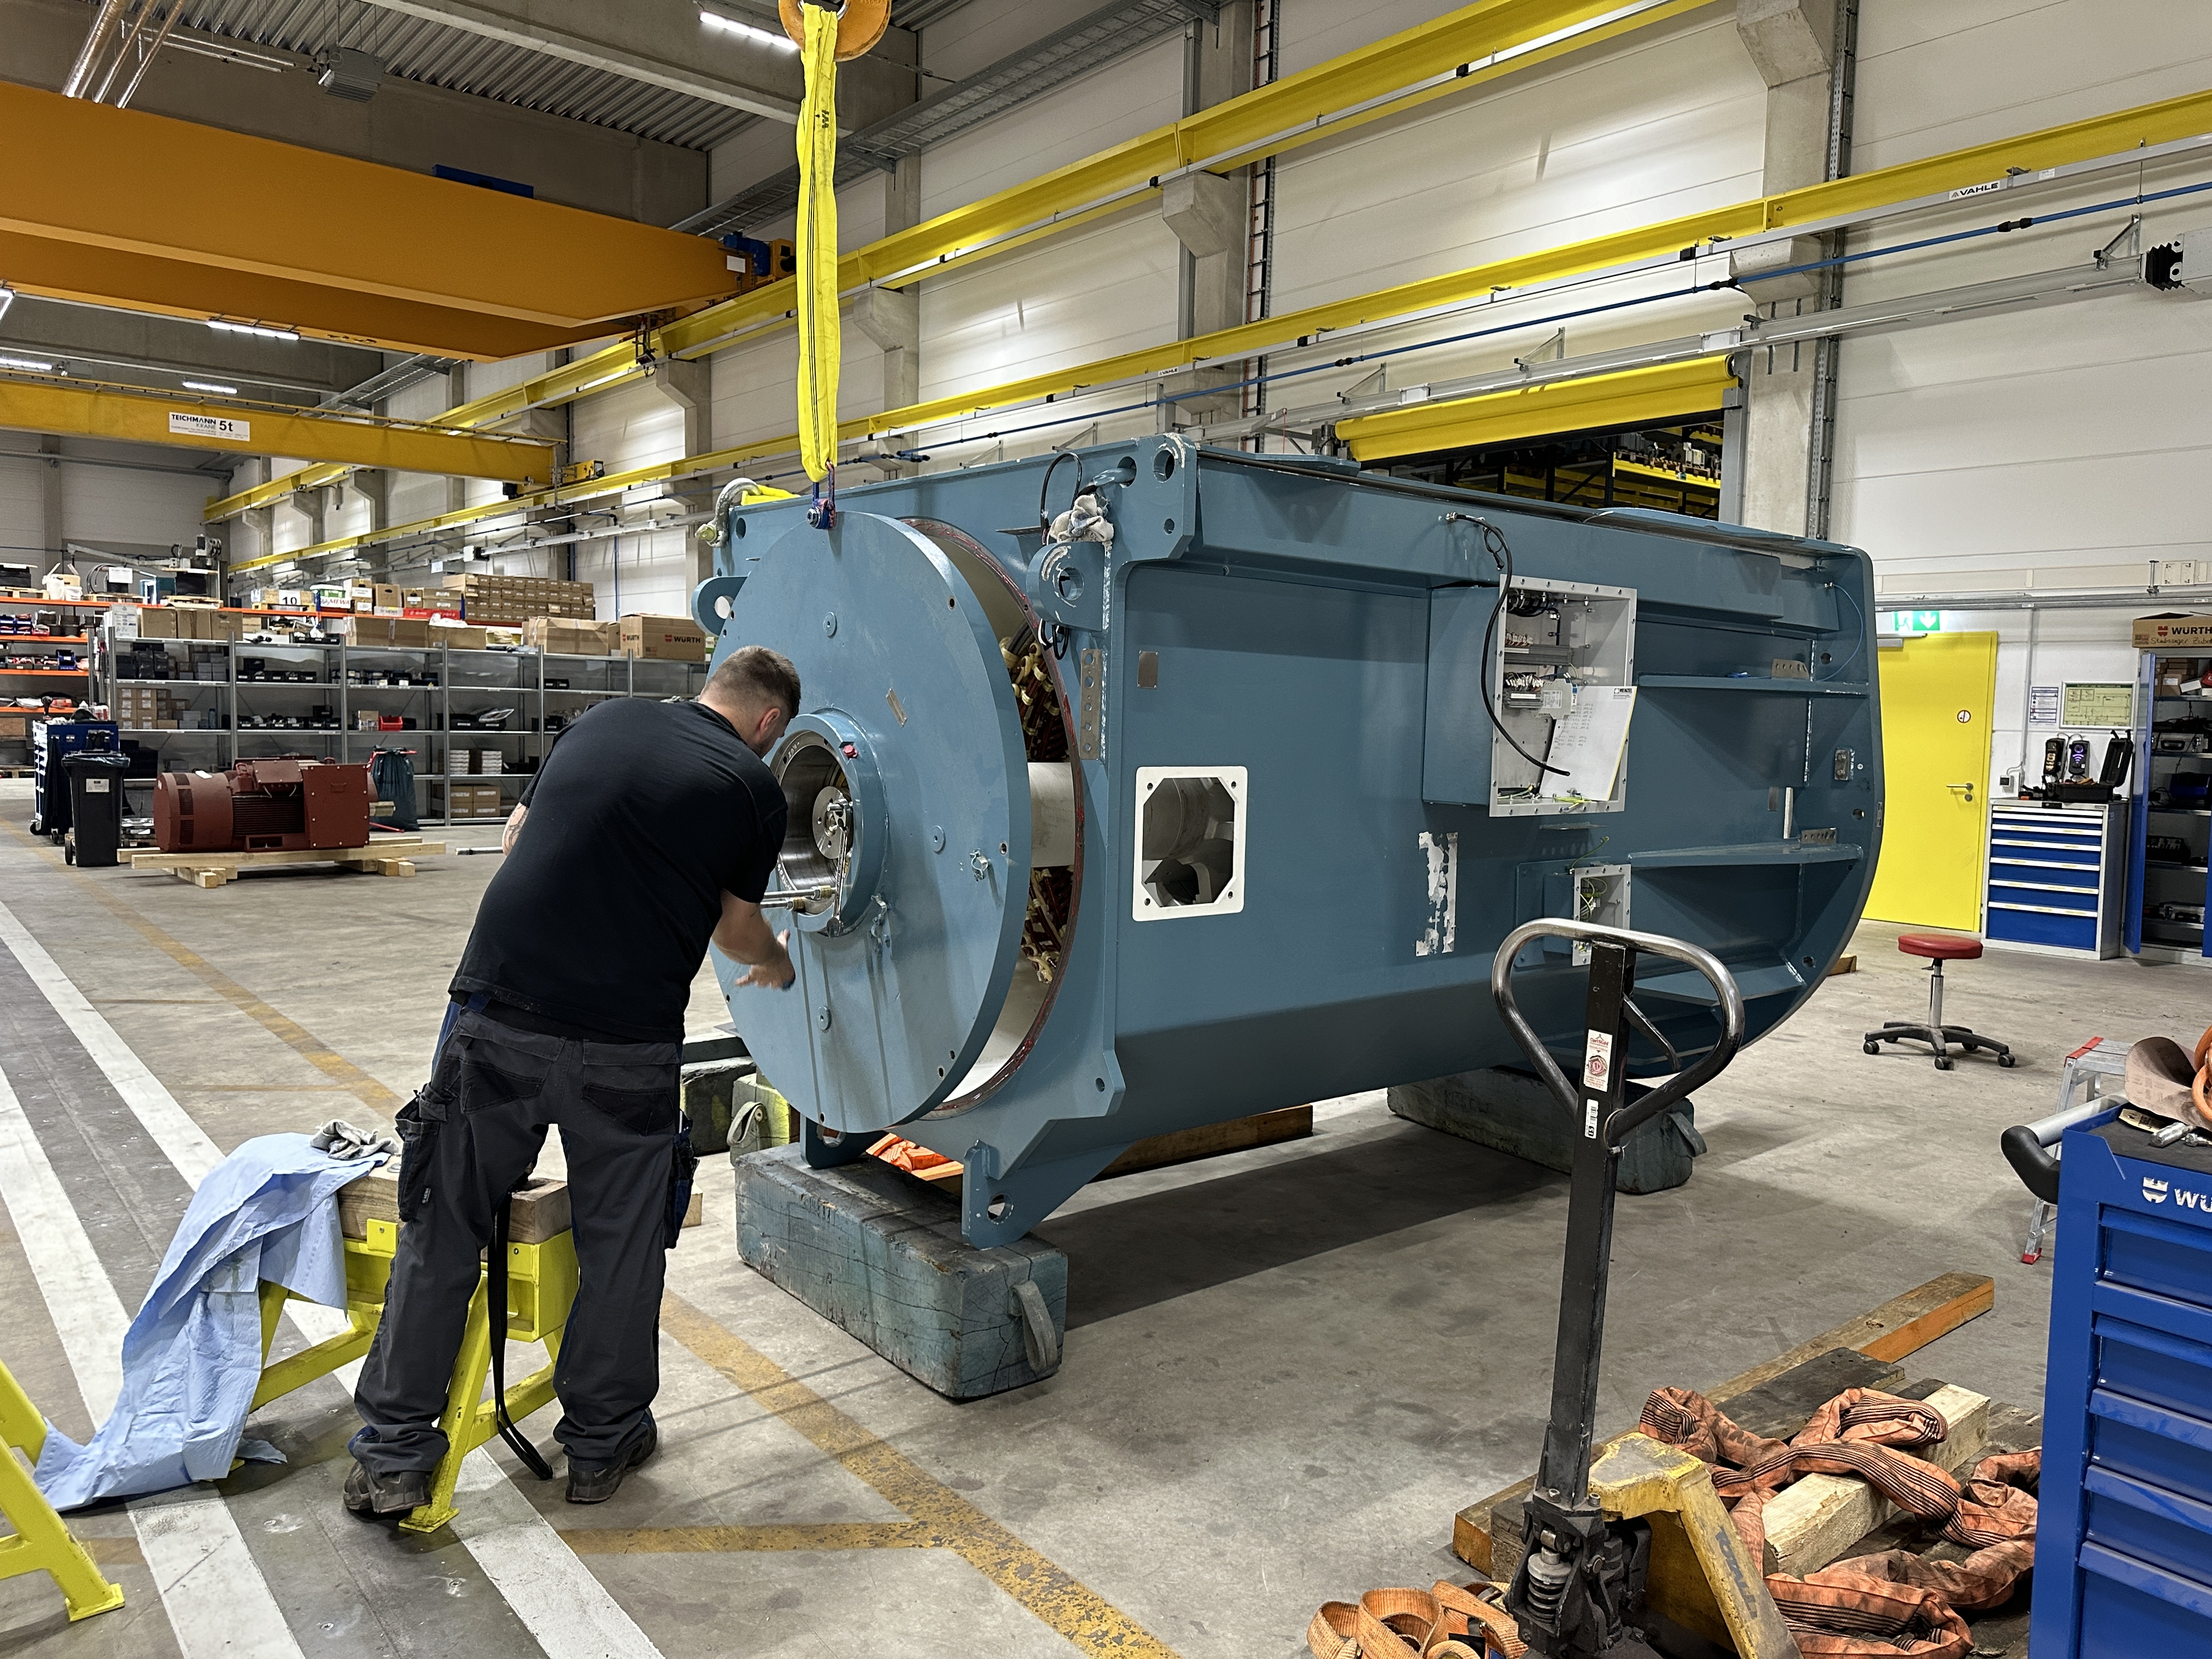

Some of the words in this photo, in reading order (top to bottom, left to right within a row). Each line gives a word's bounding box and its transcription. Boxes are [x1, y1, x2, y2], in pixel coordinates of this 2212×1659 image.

[1960, 183, 1999, 196] VAHLE
[171, 414, 216, 425] TEICHMANN
[2171, 627, 2212, 635] WÜRTH
